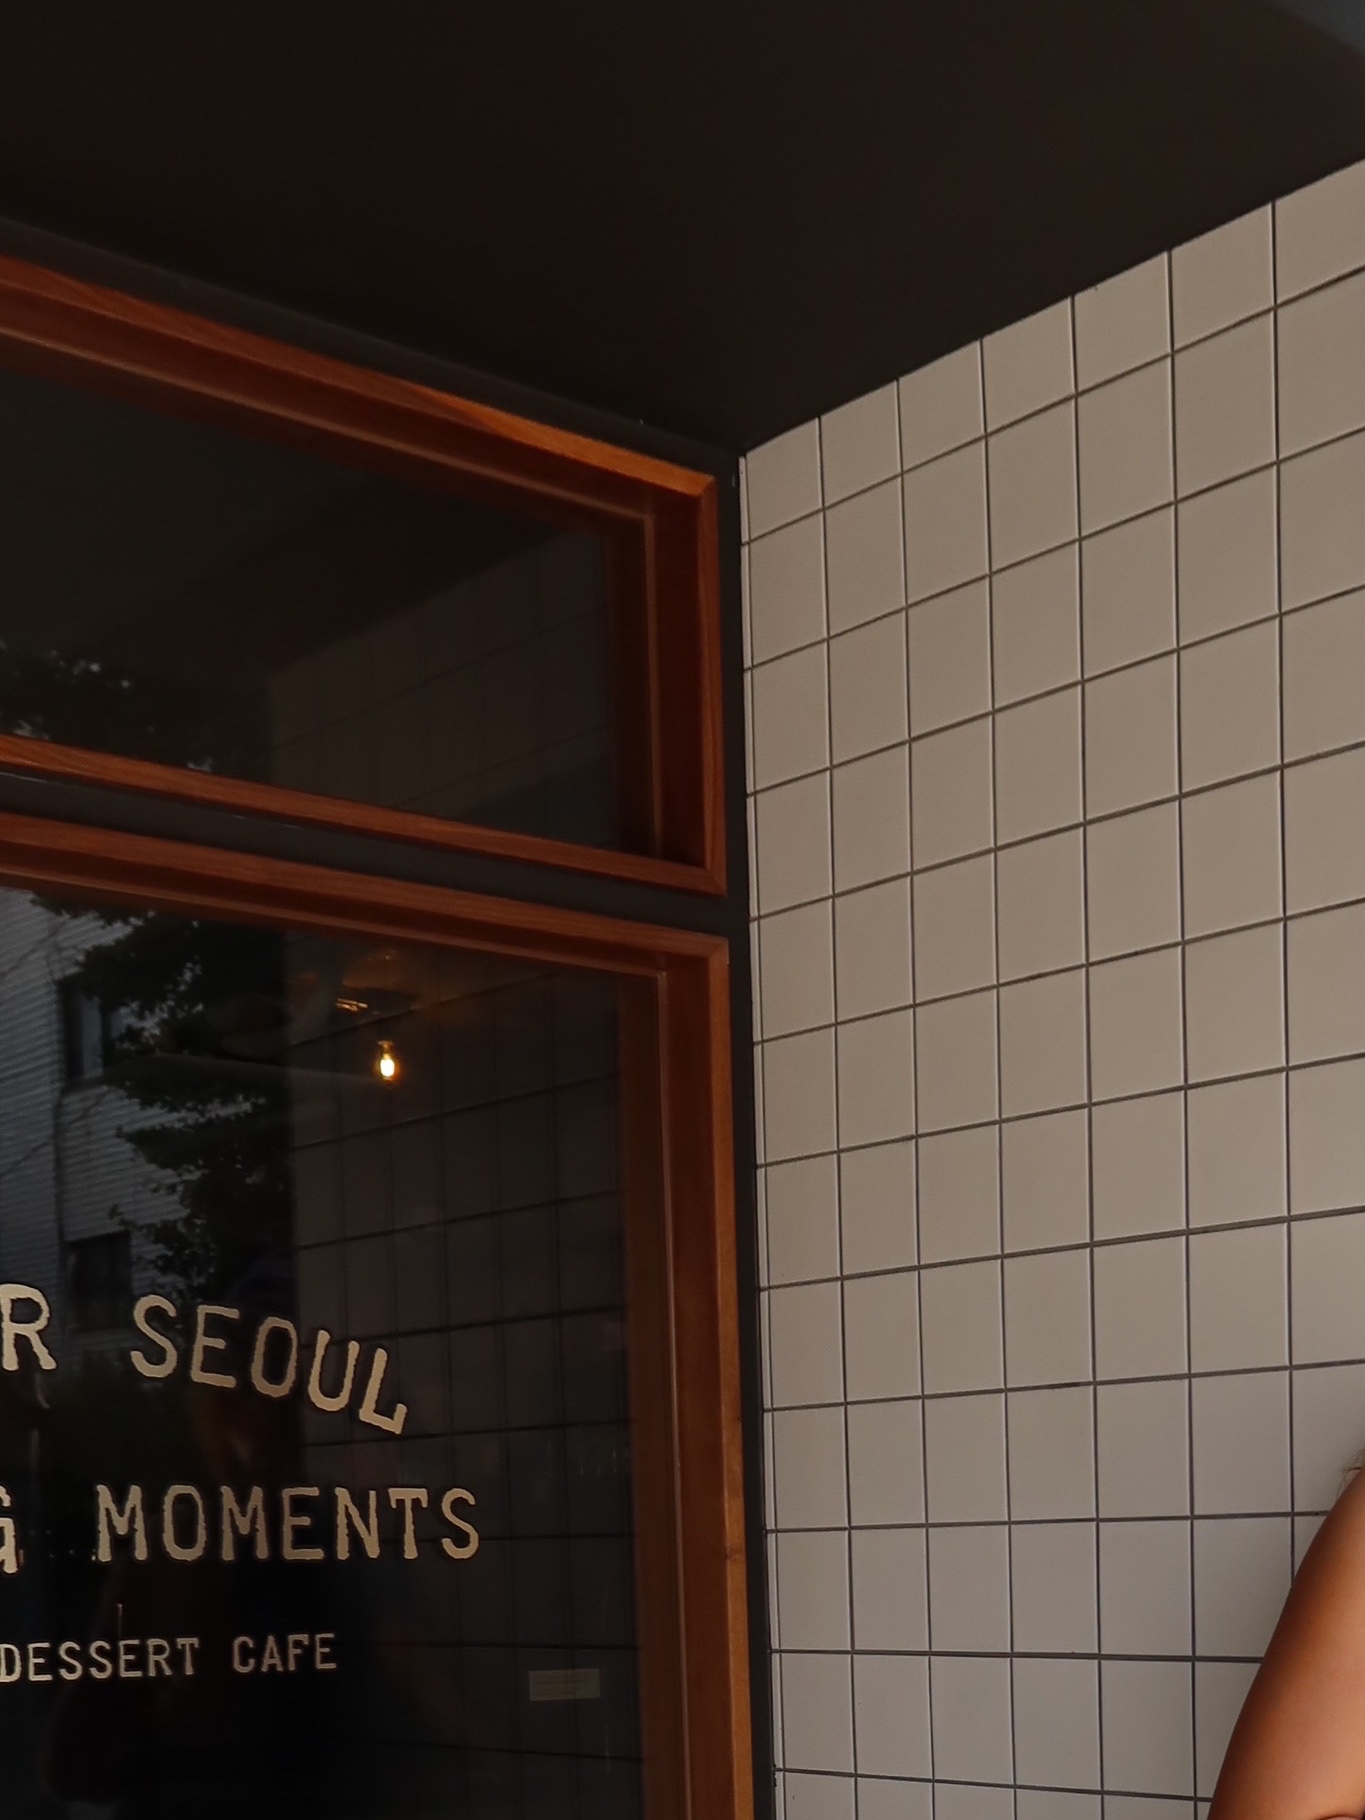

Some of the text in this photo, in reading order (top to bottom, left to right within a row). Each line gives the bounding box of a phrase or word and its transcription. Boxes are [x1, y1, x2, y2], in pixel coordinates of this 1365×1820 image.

[130, 1294, 408, 1434] SEOUL
[96, 1484, 480, 1562] MOMENTS
[0, 1633, 338, 1683] DESSERT CAFE
